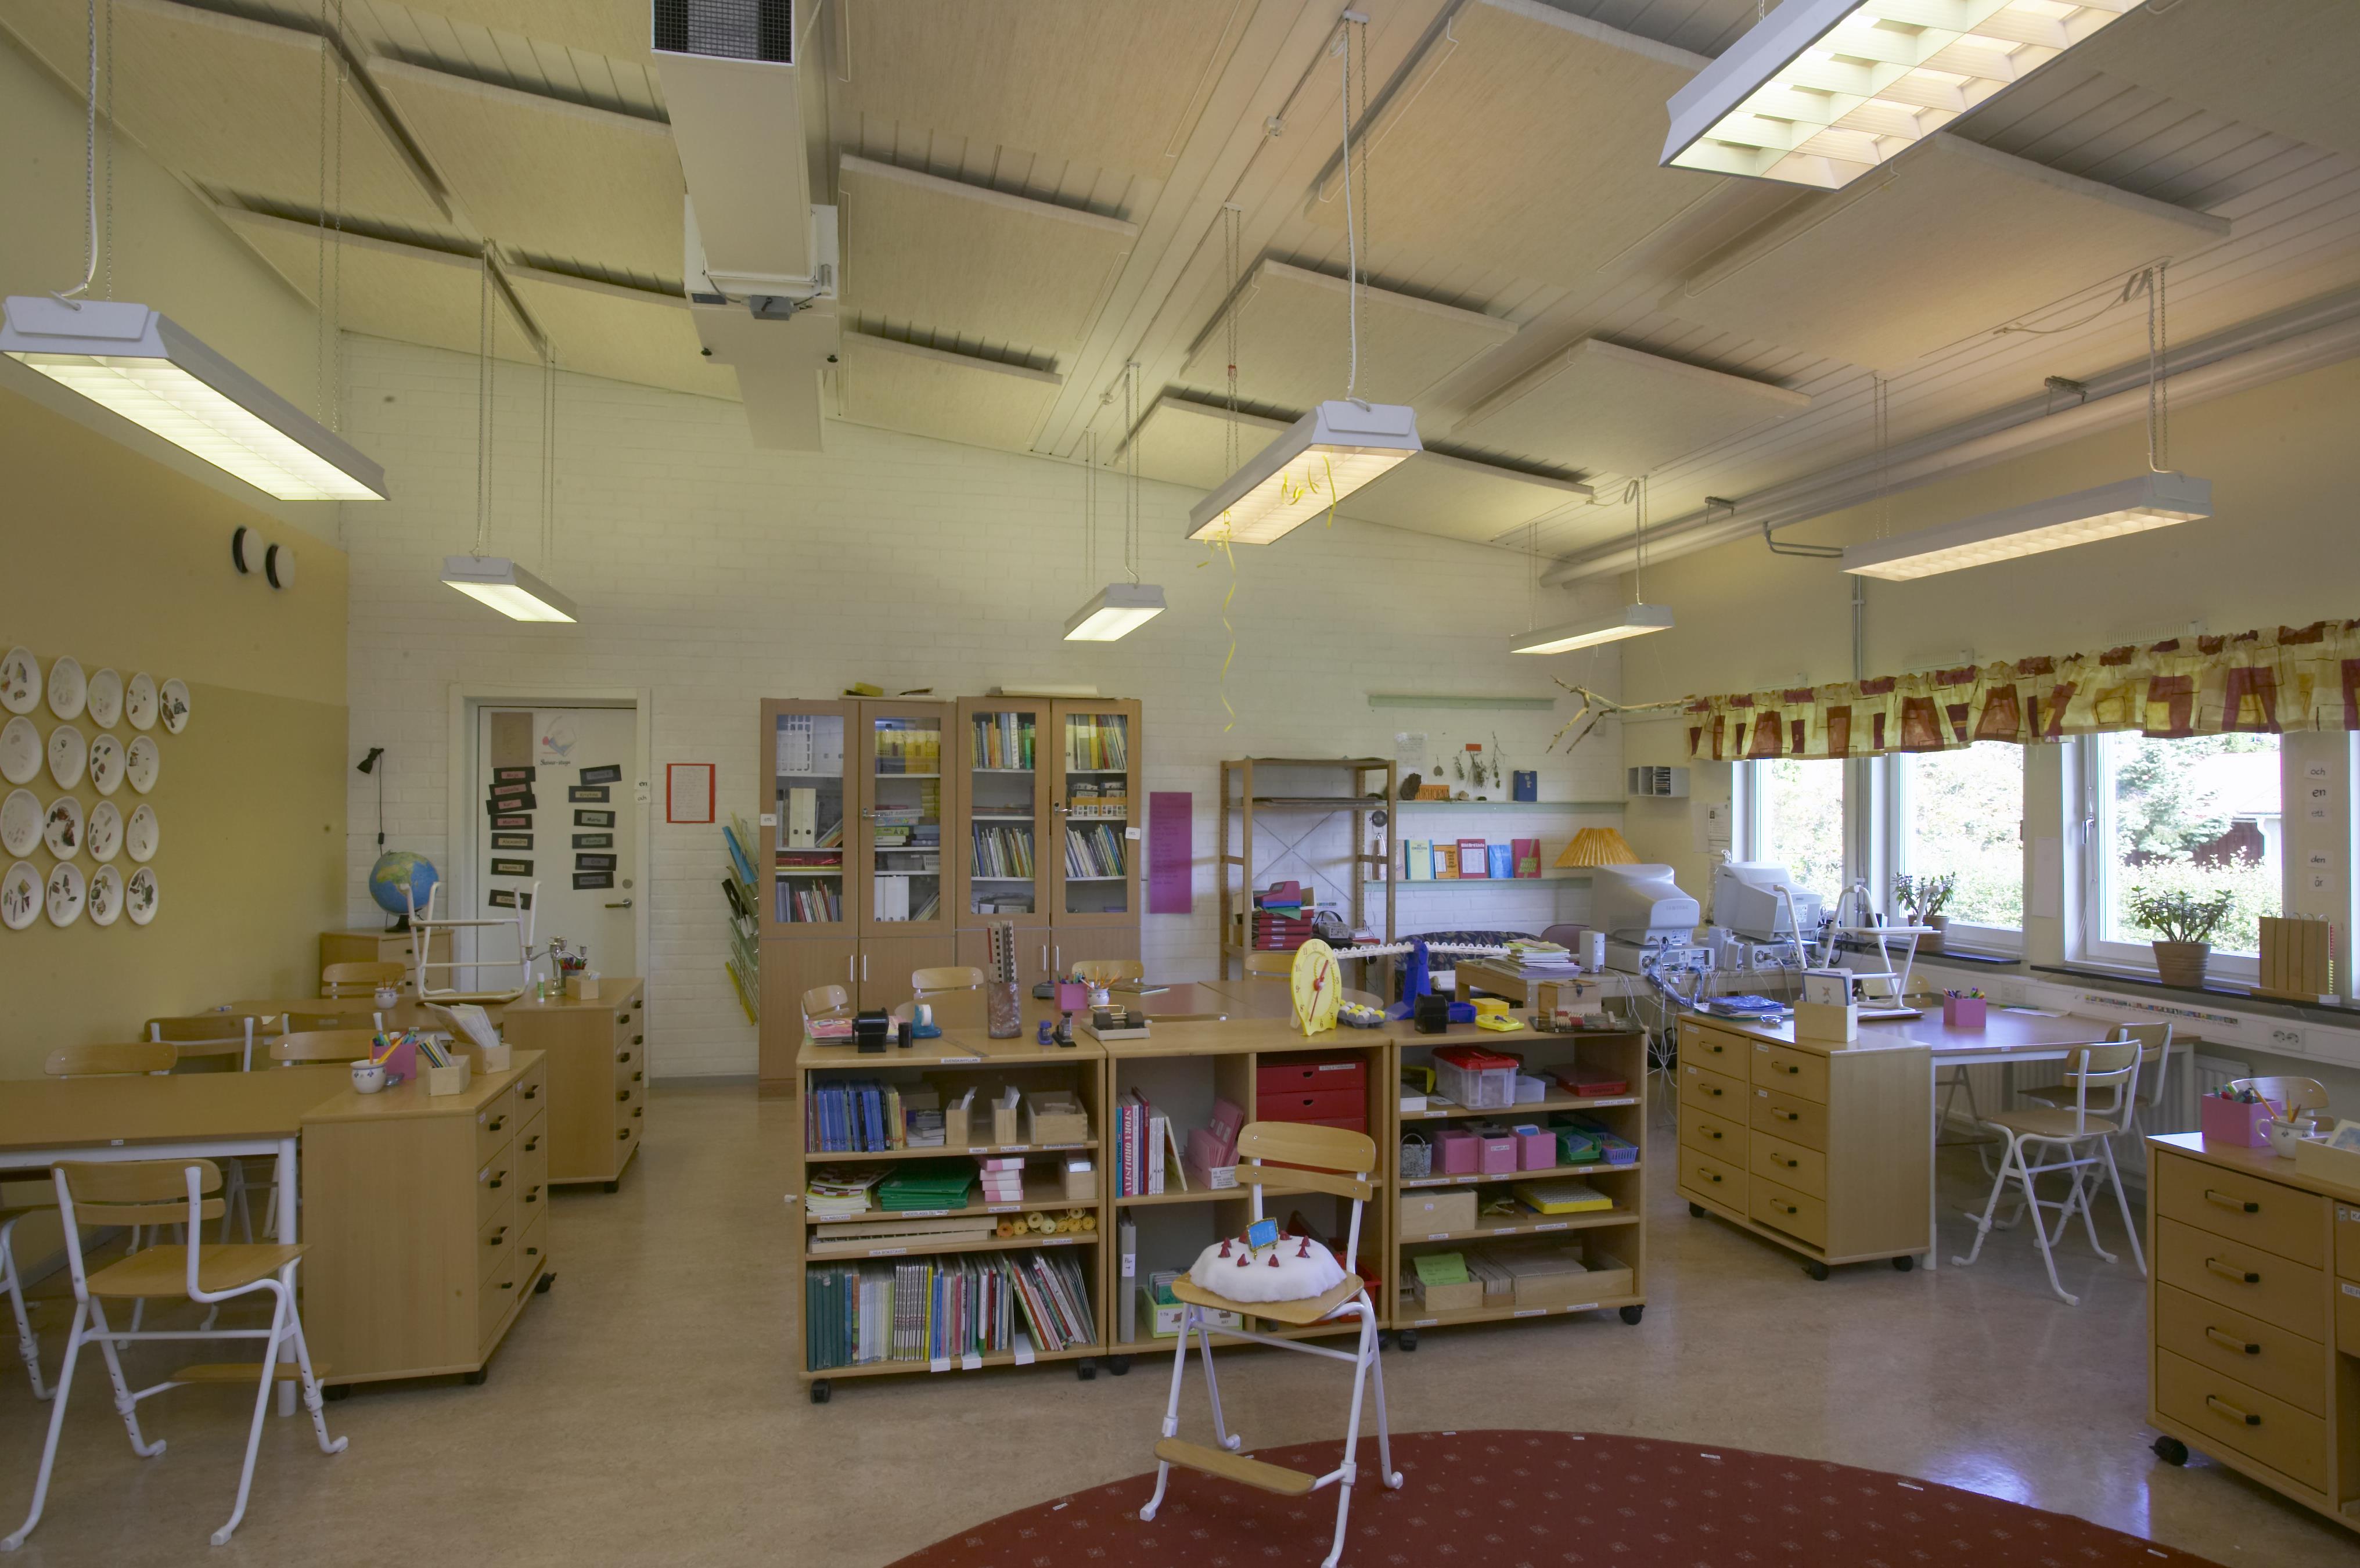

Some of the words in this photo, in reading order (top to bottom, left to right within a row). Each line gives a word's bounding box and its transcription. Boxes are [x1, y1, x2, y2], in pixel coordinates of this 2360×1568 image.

[2310, 767, 2326, 776] och
[2312, 789, 2326, 797] en
[2311, 855, 2326, 864] den
[2314, 876, 2323, 887] är
